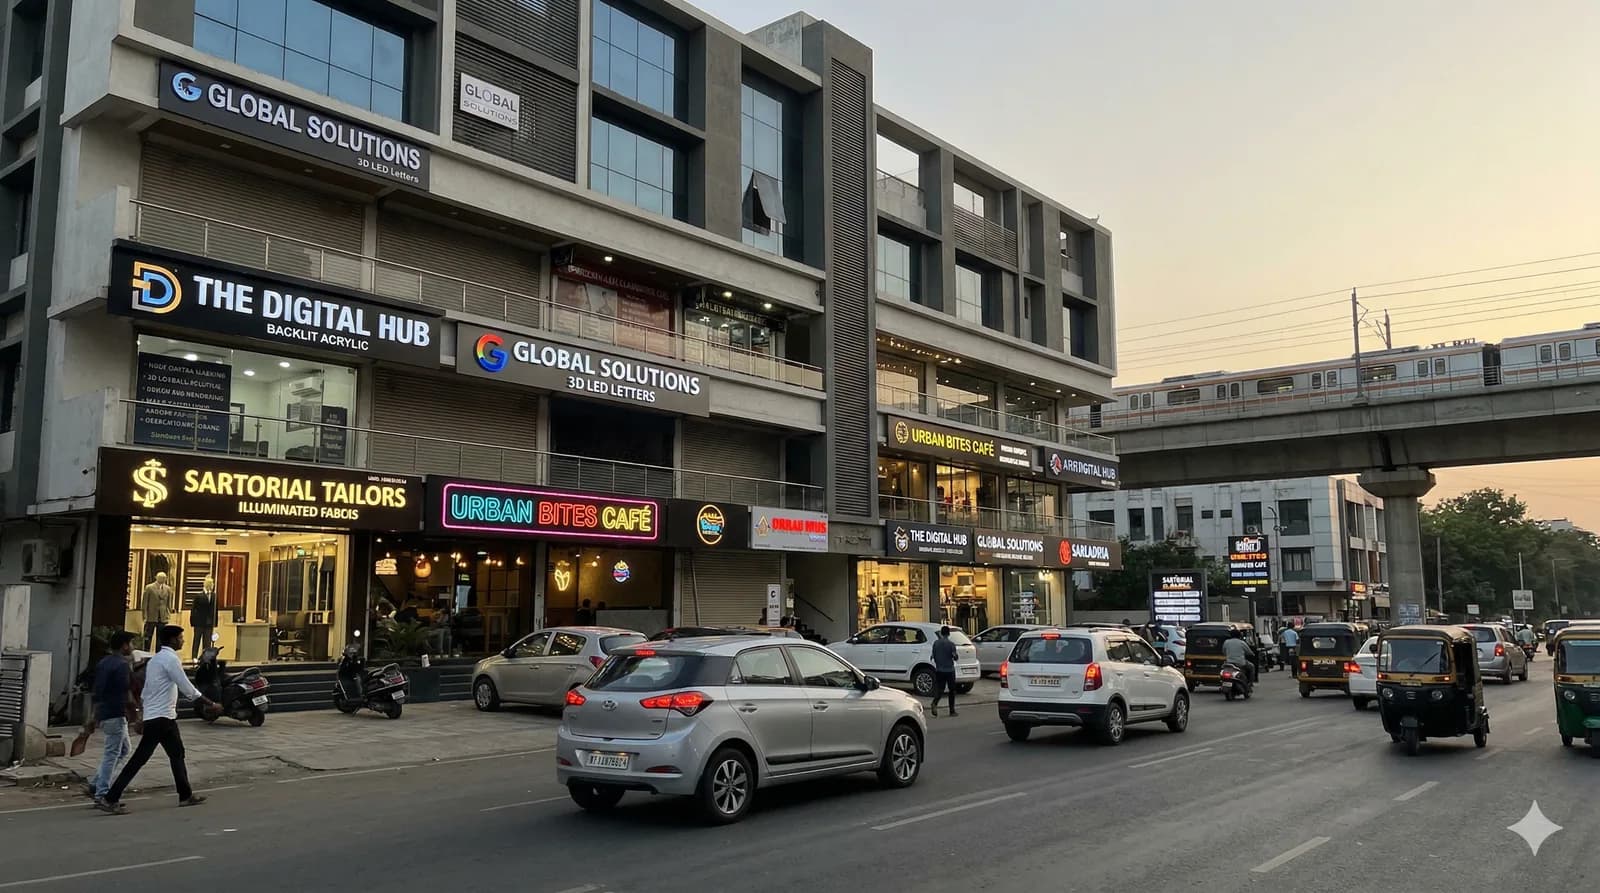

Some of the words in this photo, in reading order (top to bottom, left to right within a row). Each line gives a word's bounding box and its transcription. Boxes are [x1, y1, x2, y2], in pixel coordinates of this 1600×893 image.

[465, 83, 517, 112] GLOBAL
[208, 83, 302, 133] GLOBAL
[306, 115, 421, 170] SOLUTIONS
[463, 100, 518, 125] SOLUTIONS
[357, 157, 369, 168] 3D
[371, 161, 389, 174] LED
[390, 167, 420, 184] Letters
[193, 275, 253, 315] THE
[262, 289, 371, 337] DIGITAL
[378, 313, 430, 347] HUB
[266, 323, 318, 343] BACKLIT
[320, 334, 369, 351] ACRYLIC
[513, 341, 595, 375] GLOBAL
[600, 358, 700, 395] SOLUTIONS
[568, 376, 585, 390] 3D
[587, 379, 608, 394] LED
[611, 384, 656, 403] LETTERS
[911, 428, 945, 447] URBAN
[946, 435, 972, 452] BITES
[973, 439, 995, 457] CAFÉ
[1102, 466, 1116, 479] HUB
[184, 469, 316, 501] SARTORIAL
[322, 481, 406, 508] TAILORS
[238, 501, 318, 517] ILLUMINATED
[451, 494, 533, 523] URBAN
[538, 501, 598, 527] BITES
[602, 505, 651, 532] CAFÉ
[910, 529, 925, 542] THE
[925, 530, 952, 545] DIGITAL
[952, 534, 968, 546] HUB
[977, 535, 1005, 550] GLOBAL
[1006, 537, 1043, 552] SOLUTIONS
